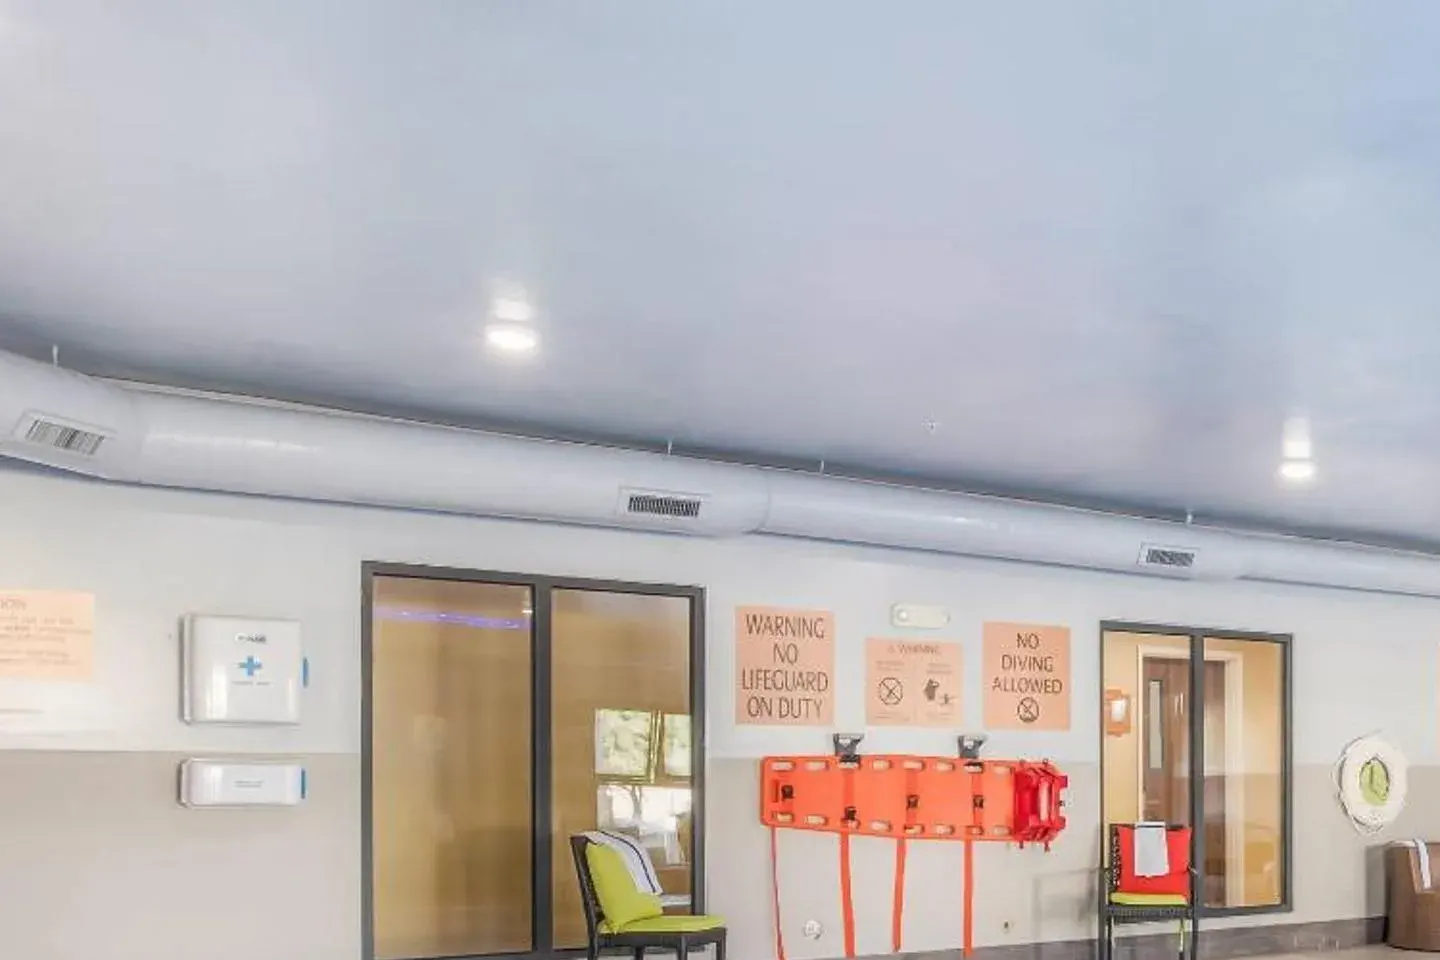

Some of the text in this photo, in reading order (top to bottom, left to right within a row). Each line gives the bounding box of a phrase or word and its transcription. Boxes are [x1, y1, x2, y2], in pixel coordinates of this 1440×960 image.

[745, 614, 825, 639] WARNING
[1016, 632, 1040, 650] NO
[773, 643, 799, 665] NO
[1001, 654, 1054, 673] DIVING
[741, 668, 829, 693] LIFEGUARD
[991, 676, 1063, 695] ALLOWED
[746, 696, 823, 720] ON DUTY
